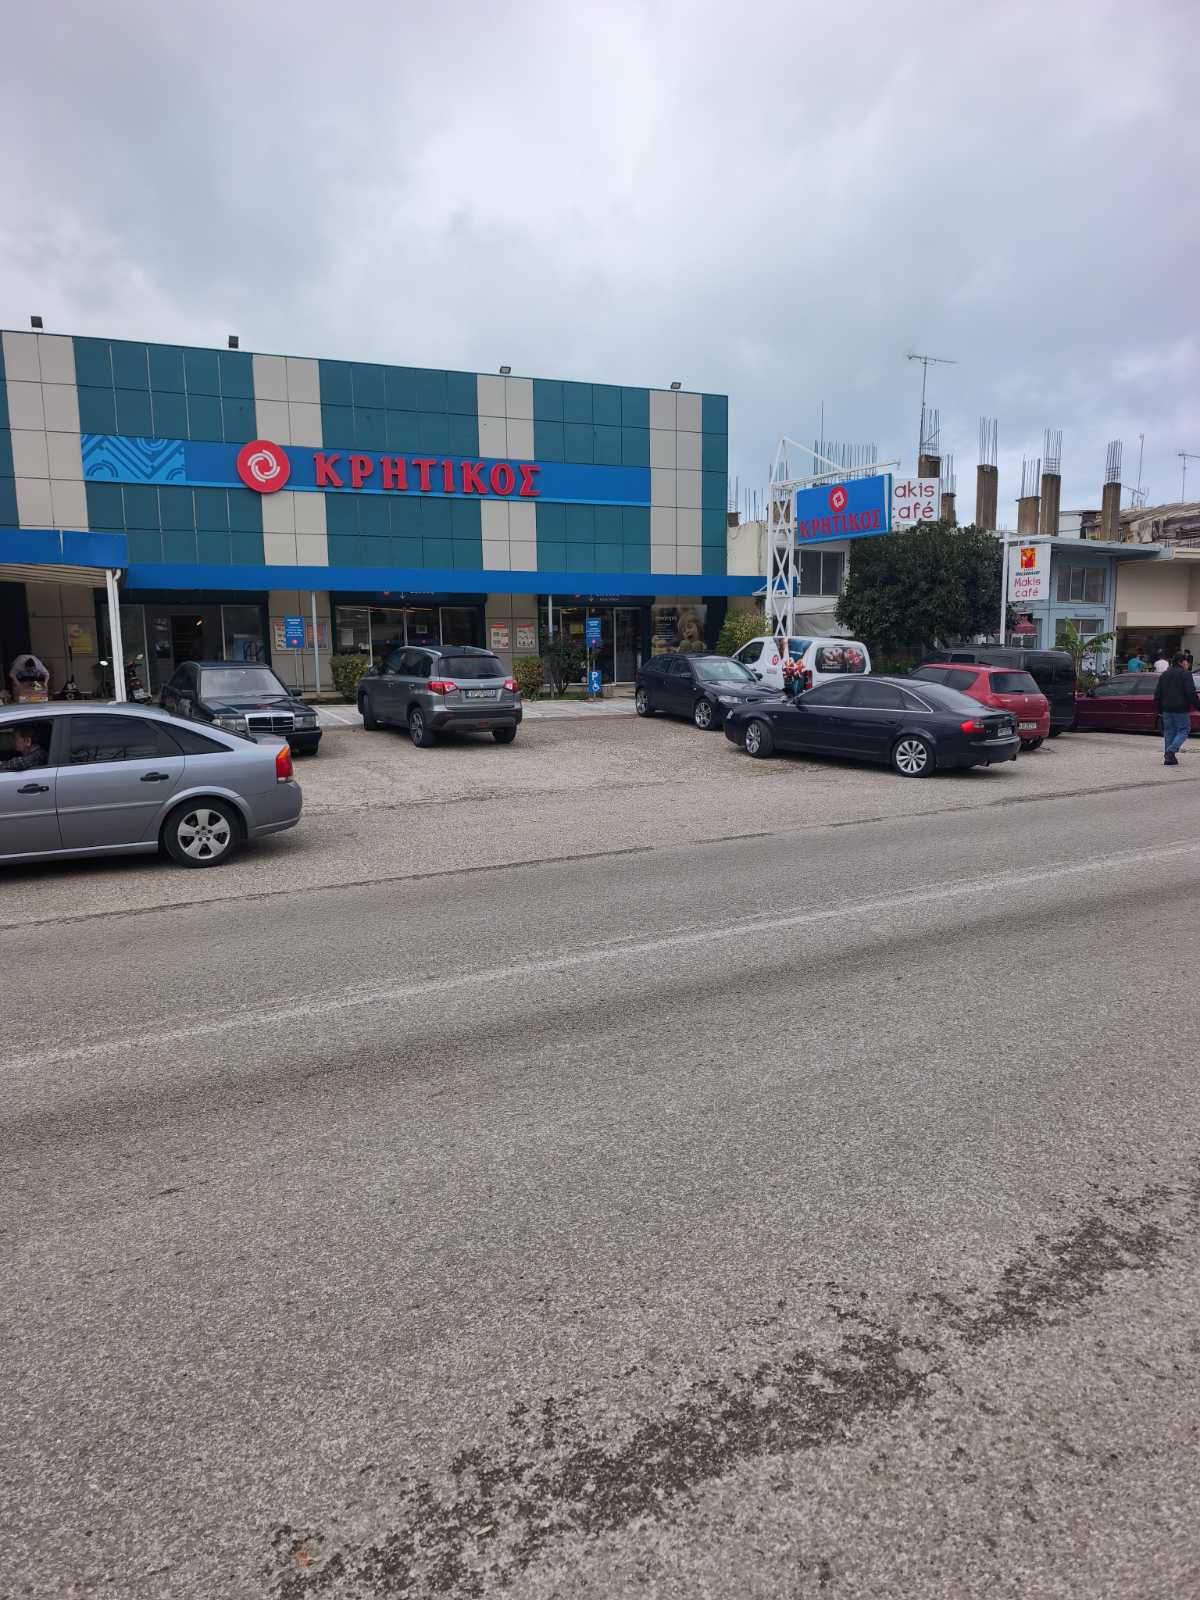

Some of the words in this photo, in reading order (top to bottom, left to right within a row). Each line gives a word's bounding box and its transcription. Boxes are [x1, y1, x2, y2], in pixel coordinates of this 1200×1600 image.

[313, 452, 542, 497] ΚΡΗΤΙΚΟΣ
[895, 481, 935, 498] akis
[800, 509, 881, 539] ΚΡΗΤΙΚΟΣ
[1014, 577, 1041, 588] Makis
[1015, 587, 1039, 598] café
